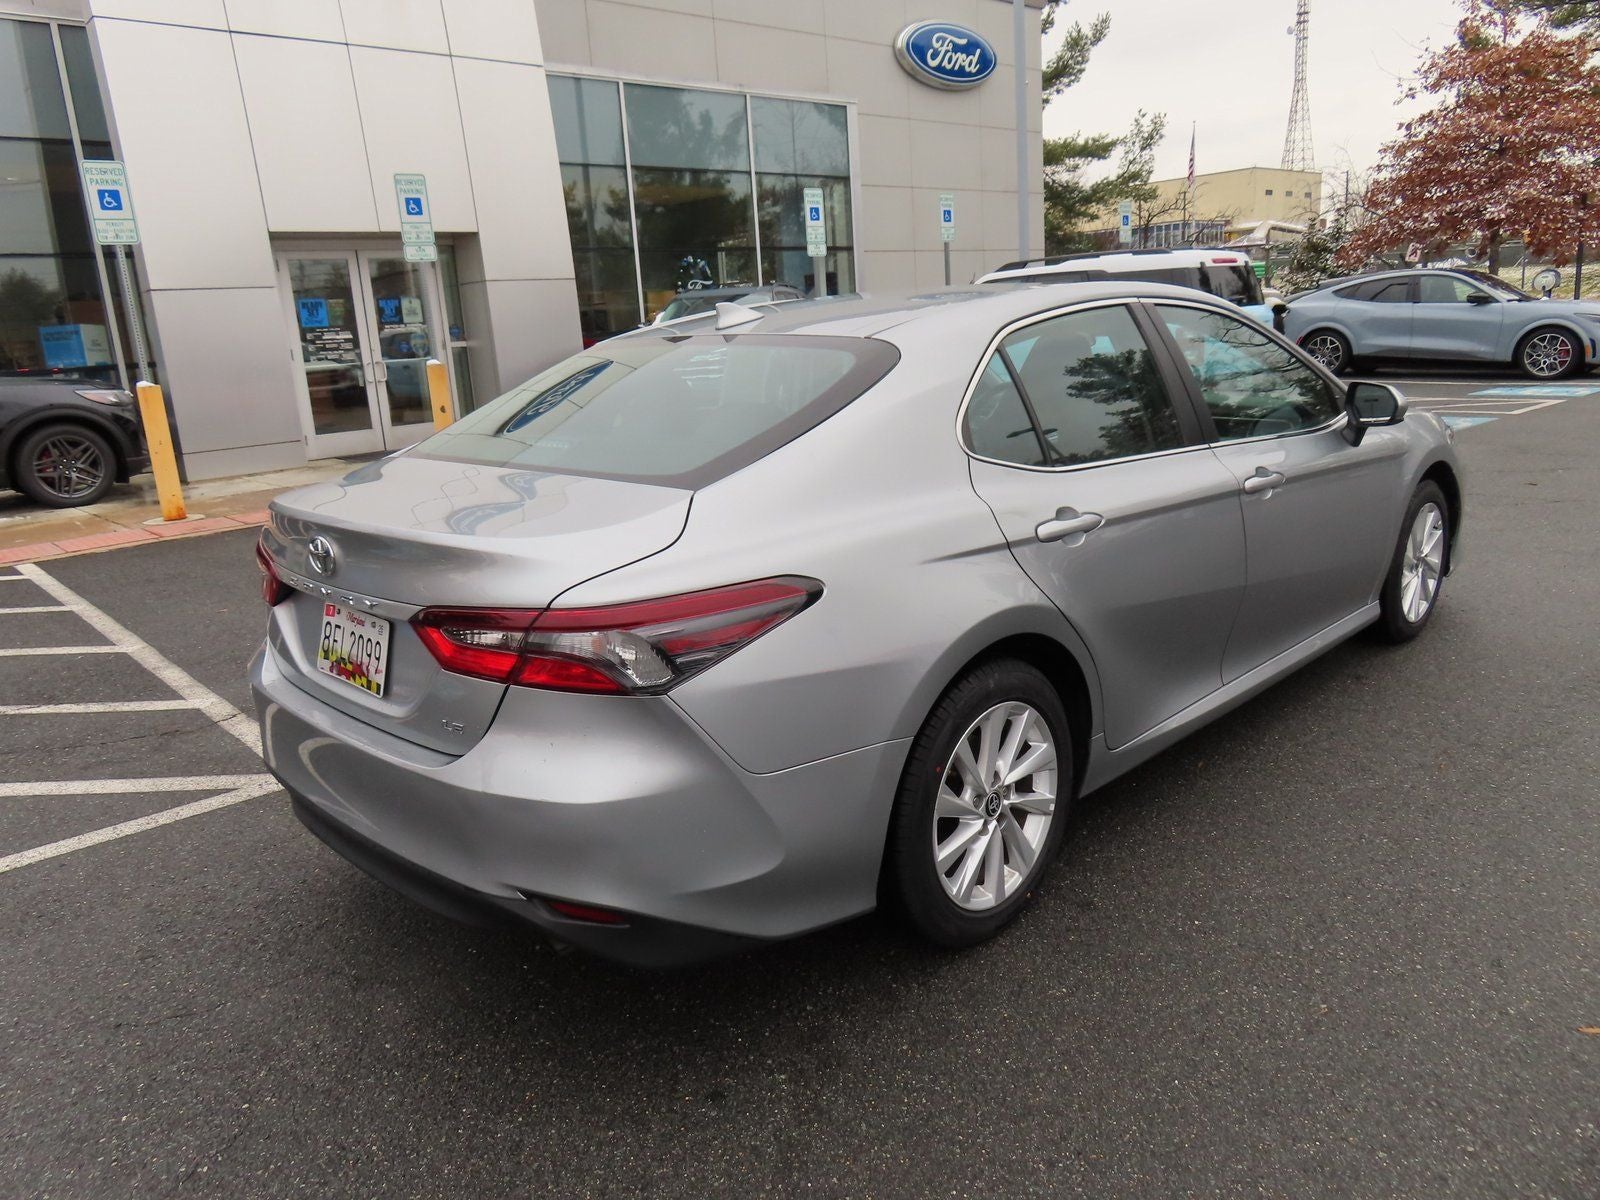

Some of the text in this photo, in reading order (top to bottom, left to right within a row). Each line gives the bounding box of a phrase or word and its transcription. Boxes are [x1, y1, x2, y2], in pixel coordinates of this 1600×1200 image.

[927, 32, 981, 73] Ford
[84, 167, 124, 176] RESERVED
[89, 178, 123, 187] PARKING
